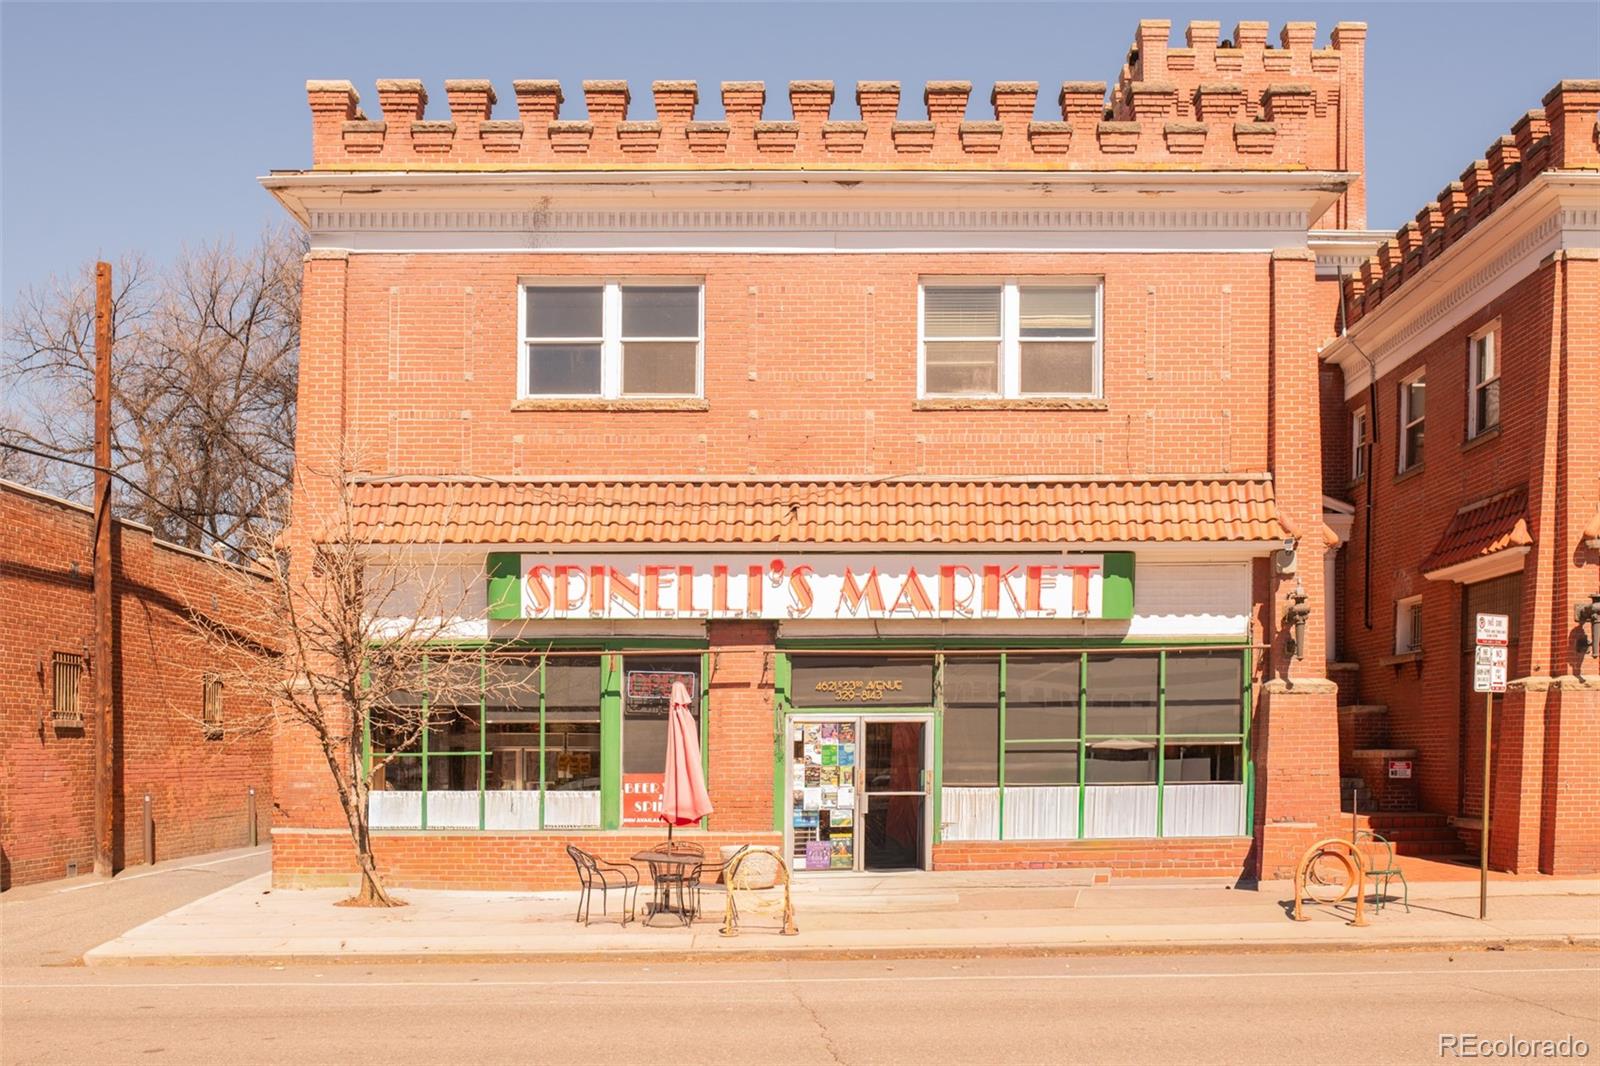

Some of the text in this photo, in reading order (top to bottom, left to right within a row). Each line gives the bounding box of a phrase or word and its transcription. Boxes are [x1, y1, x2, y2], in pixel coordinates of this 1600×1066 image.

[524, 558, 1100, 618] SPINELLI'S MARKET
[865, 680, 903, 691] AVENUE
[834, 690, 883, 701] 329-8143
[624, 782, 660, 794] BEER
